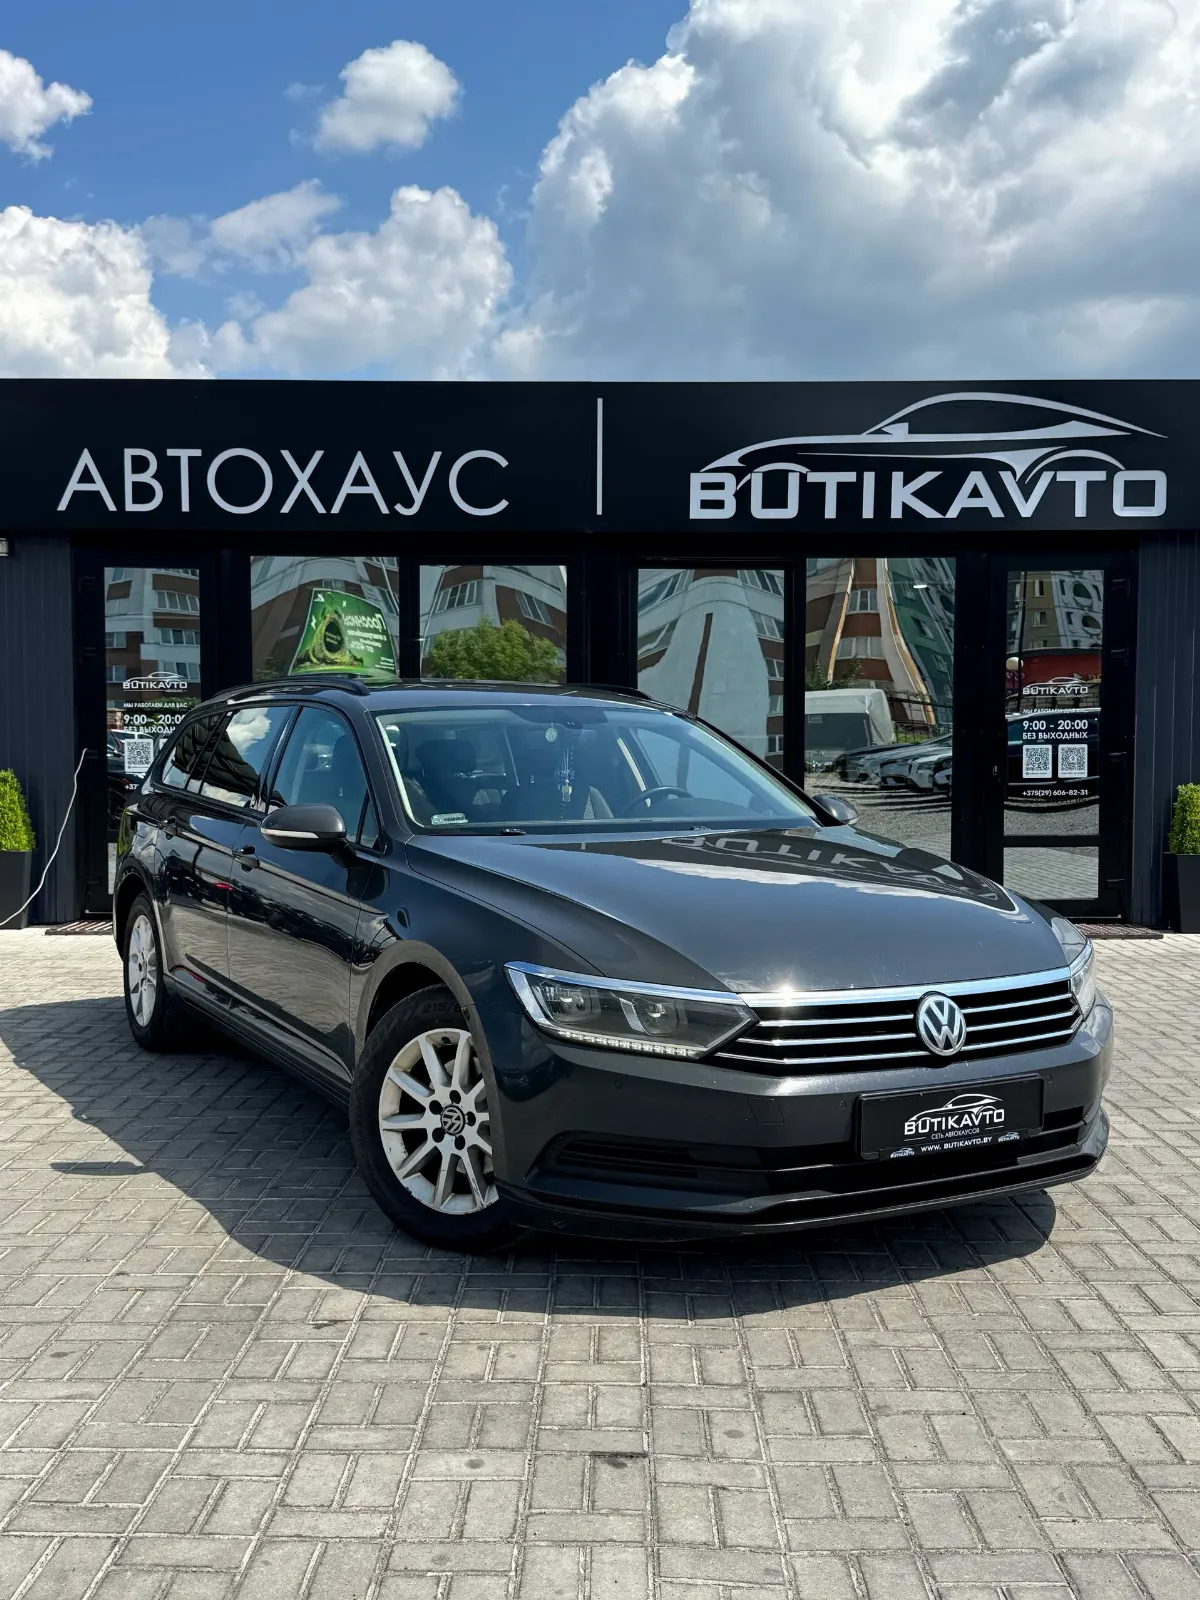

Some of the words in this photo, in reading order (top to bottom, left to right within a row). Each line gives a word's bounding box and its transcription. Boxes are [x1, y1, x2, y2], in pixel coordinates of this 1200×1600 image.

[57, 447, 510, 516] АВТОХАУС
[689, 469, 1168, 520] BUTIKAVTO
[123, 681, 188, 689] BUTIKAVTO
[1022, 686, 1088, 694] BUTIKAVTO
[124, 714, 147, 724] 9:00
[1022, 720, 1046, 730] 9:00
[1058, 720, 1088, 730] 20:00
[1038, 732, 1088, 740] ВЫХОДНЫХ
[904, 1108, 1004, 1136] BUTIKAVTO
[944, 1136, 992, 1149] BUTIKAVTO.BY
